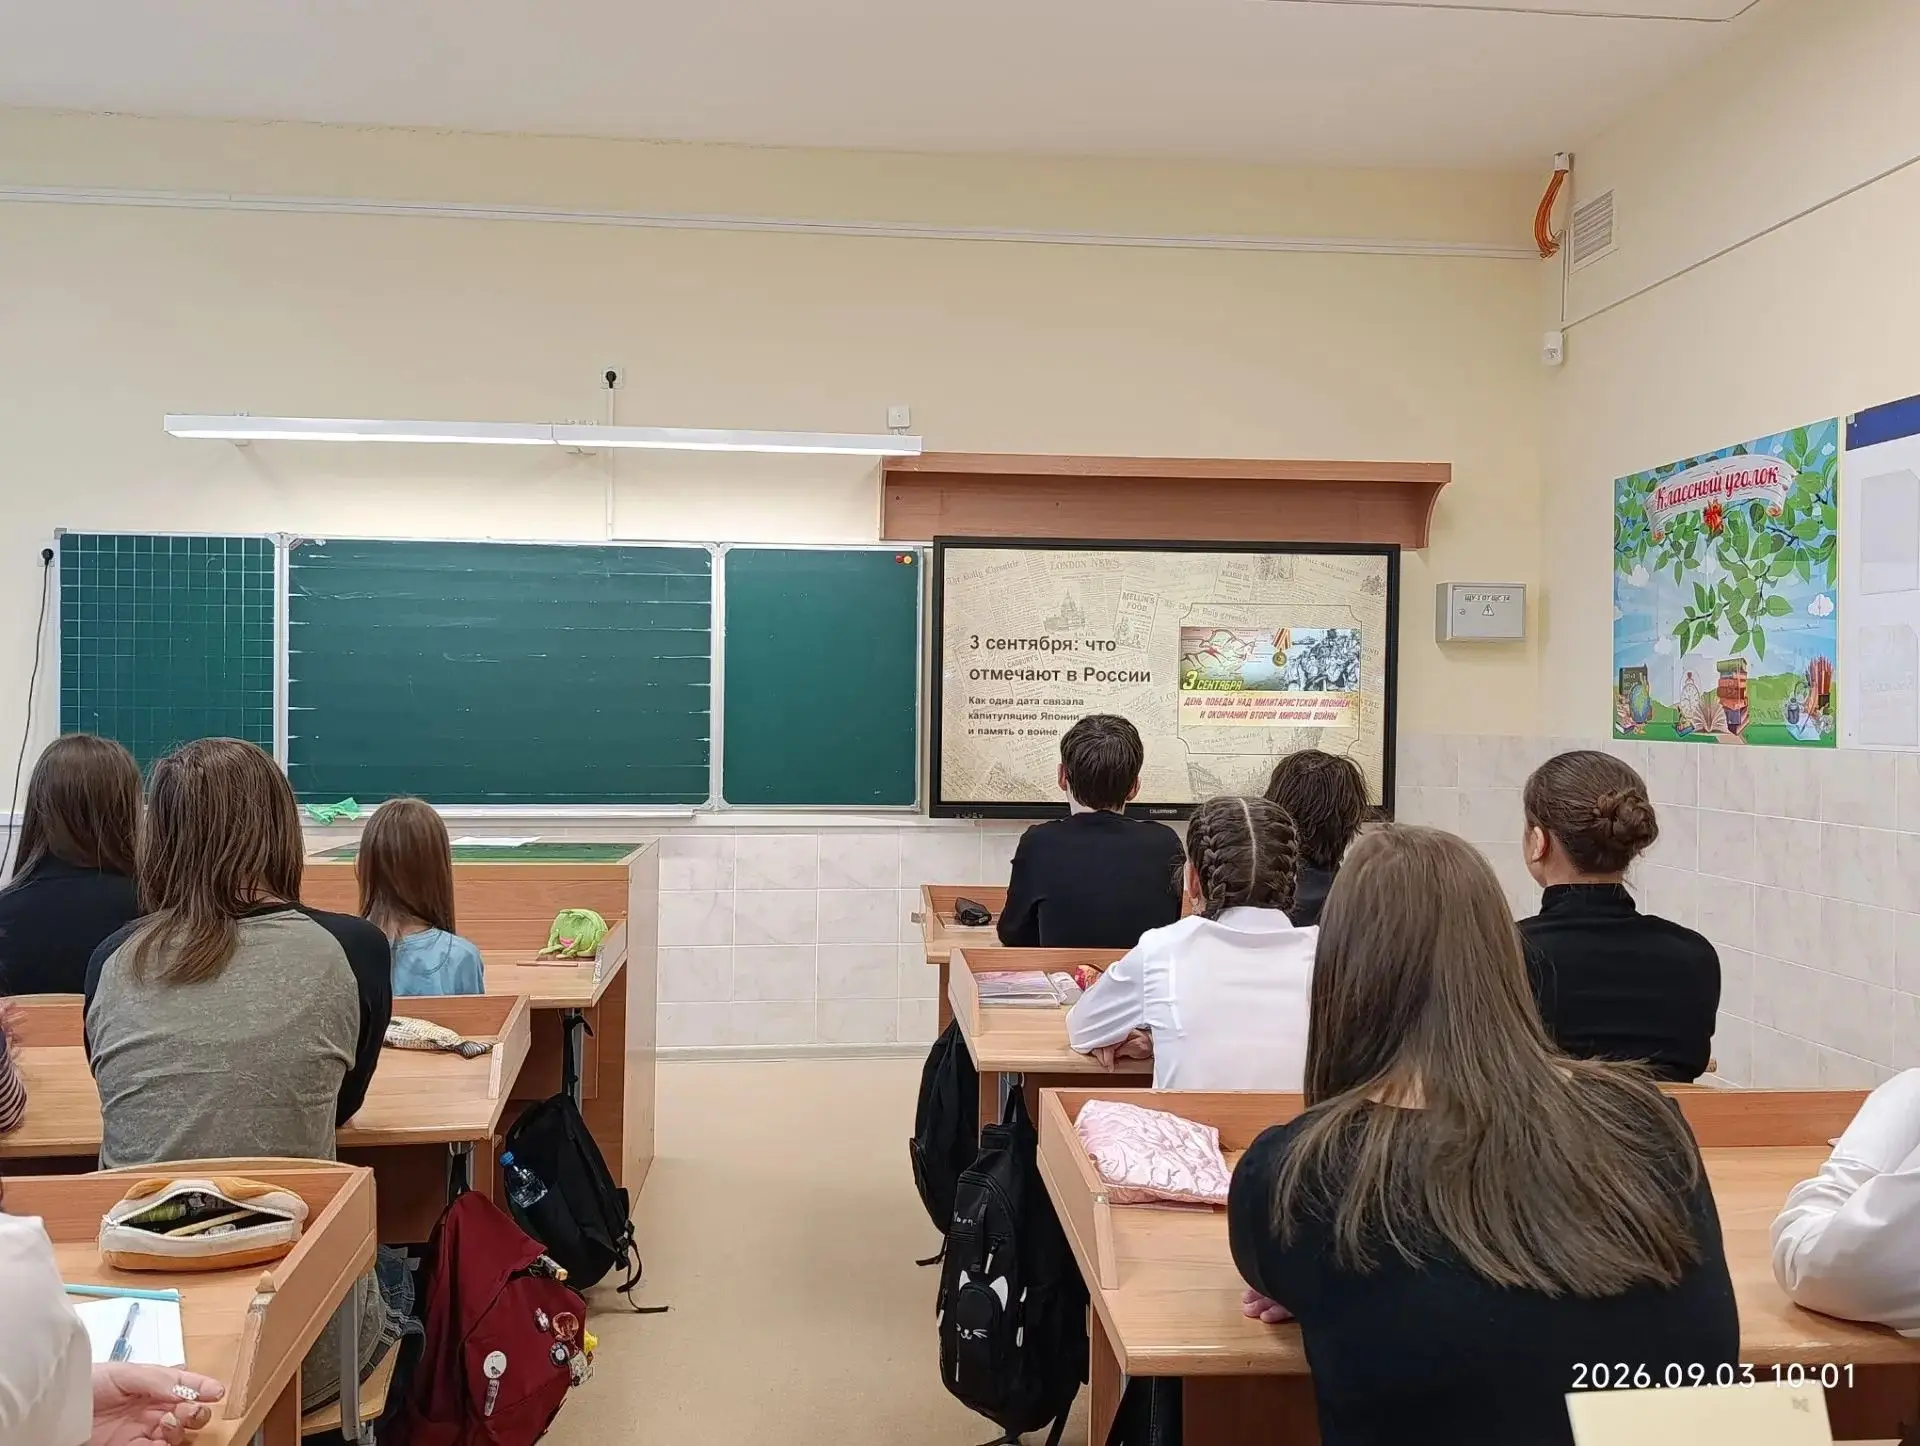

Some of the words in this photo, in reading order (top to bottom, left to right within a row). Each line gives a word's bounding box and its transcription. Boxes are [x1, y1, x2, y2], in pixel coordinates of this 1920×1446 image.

[1656, 470, 1722, 510] Классный
[1725, 466, 1780, 498] уголок
[970, 634, 980, 649] 3
[985, 635, 1079, 654] сентября:
[1085, 639, 1116, 651] что
[969, 668, 1061, 681] отмечают
[1066, 670, 1078, 681] в
[1083, 667, 1151, 682] России
[1182, 670, 1198, 690] 3
[1197, 680, 1243, 691] СЕНТЯБРЯ
[968, 696, 987, 705] Как
[1016, 698, 1040, 706] дата
[1043, 698, 1085, 706] связала
[1184, 697, 1203, 706] ДЕНЬ
[1205, 697, 1235, 706] ПОБЕДЫ
[1236, 697, 1252, 707] НАД
[968, 712, 1038, 721] капитуляцию
[1040, 712, 1080, 720] Японии
[1199, 710, 1206, 719] И
[1207, 711, 1248, 719] ОКОНЧАНИЯ
[1249, 710, 1278, 720] ВТОРОЙ
[1279, 710, 1312, 720] МИРОВОЙ
[1313, 711, 1339, 720] ВОЙНЫ
